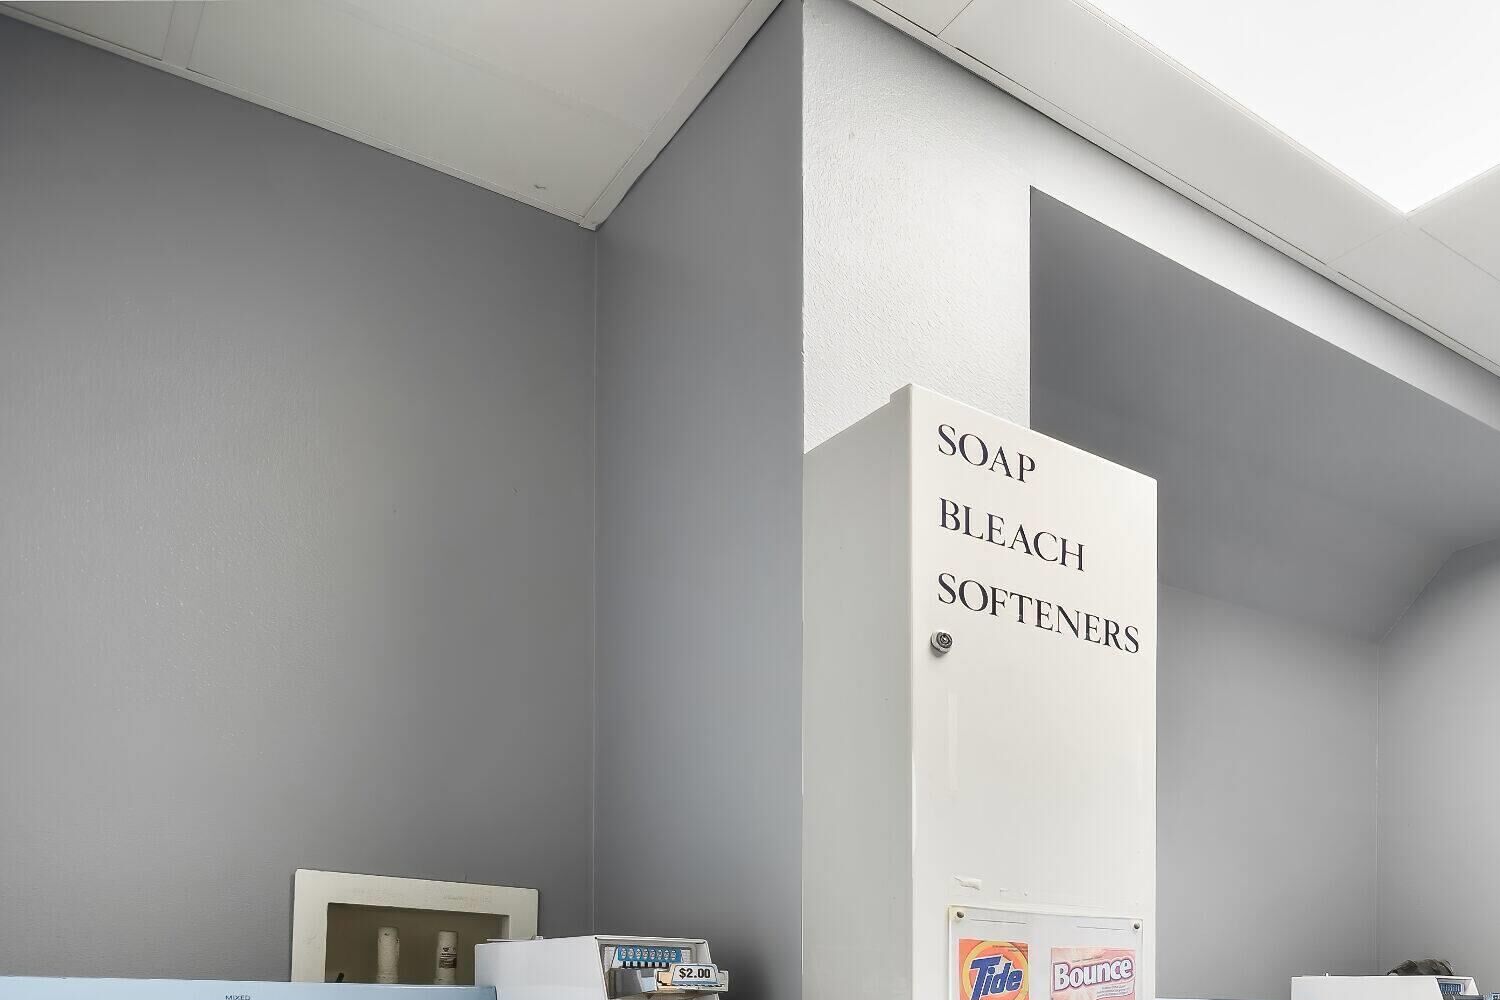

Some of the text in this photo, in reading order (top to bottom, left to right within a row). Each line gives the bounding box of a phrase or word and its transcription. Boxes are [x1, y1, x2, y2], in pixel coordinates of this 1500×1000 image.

[938, 423, 1036, 483] SOAP
[938, 497, 1085, 572] BLEACH
[937, 572, 1140, 654] SOFTENERS
[678, 967, 711, 980] $2.00
[1053, 959, 1133, 991] Bounce
